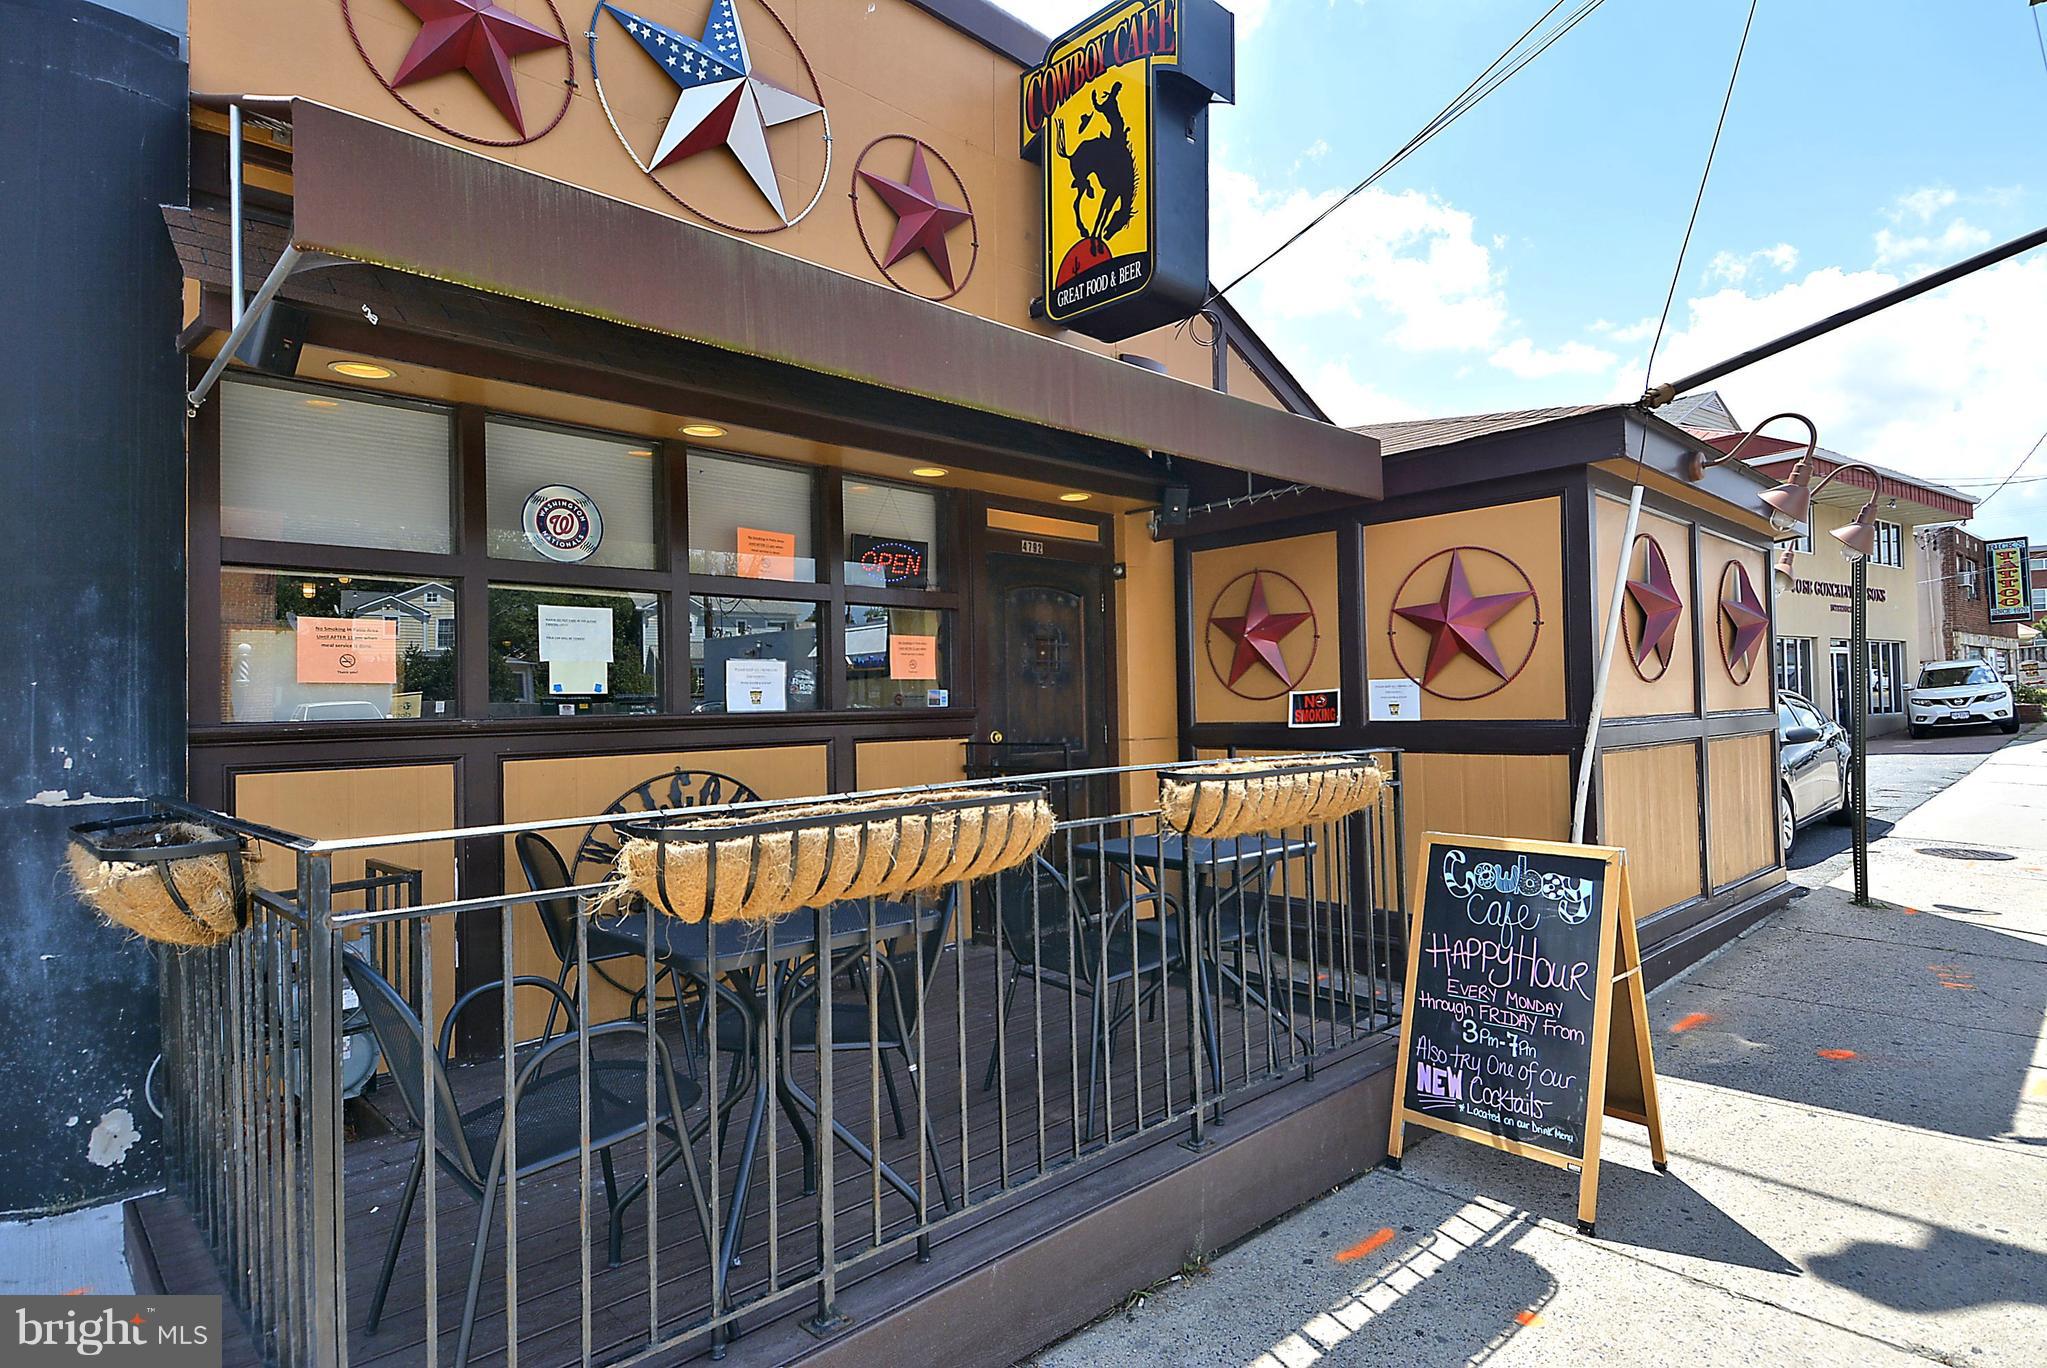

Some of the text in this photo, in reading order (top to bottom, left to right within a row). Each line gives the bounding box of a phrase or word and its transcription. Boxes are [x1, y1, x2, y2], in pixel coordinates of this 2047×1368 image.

[1026, 0, 1176, 131] COWBOY CAFE
[1057, 261, 1142, 307] GREAT FOOD & BEER
[539, 500, 587, 522] WASHINGTON
[549, 513, 575, 536] W
[541, 530, 585, 548] NATIONALS
[1022, 541, 1043, 553] 4792
[861, 550, 922, 576] OPEN
[1996, 551, 2020, 606] TATTOO
[1866, 587, 1886, 602] SONS
[1295, 708, 1336, 723] SMOKING
[1443, 850, 1594, 925] Cowboy
[1467, 893, 1541, 949] Cafe
[1418, 990, 1474, 1022] through
[1480, 1004, 1538, 1035] FRIDAY
[1447, 978, 1564, 1018] EVERY MONDAY
[1416, 1034, 1447, 1064] Also
[1518, 1061, 1539, 1090] of
[1416, 1061, 1554, 1120] NEW Cocktails
[1503, 1117, 1515, 1127] on
